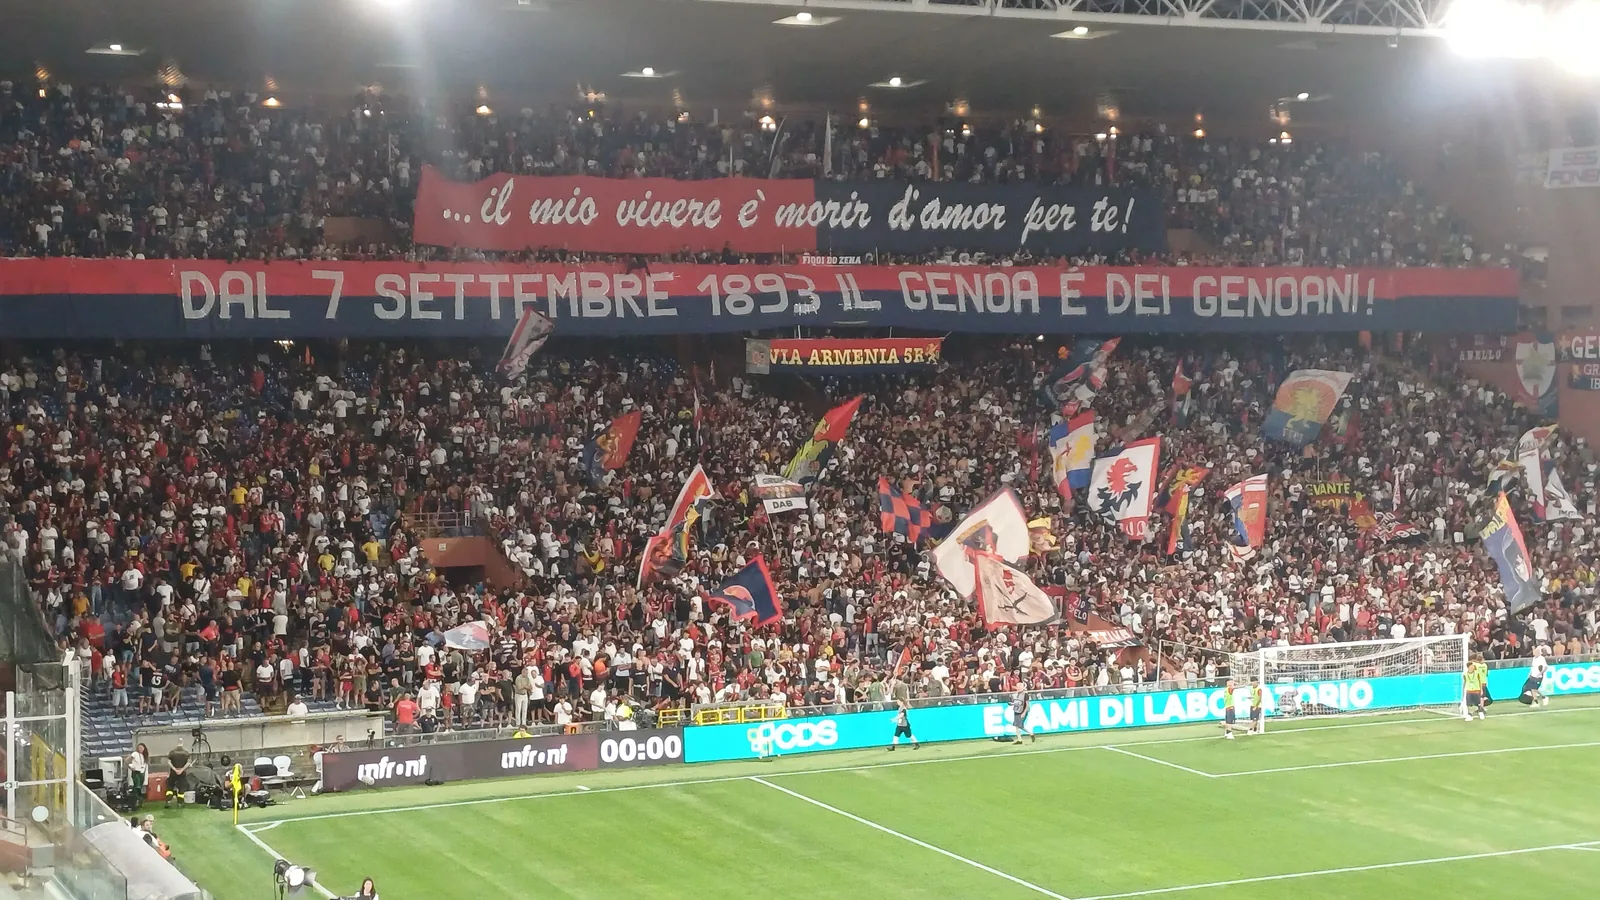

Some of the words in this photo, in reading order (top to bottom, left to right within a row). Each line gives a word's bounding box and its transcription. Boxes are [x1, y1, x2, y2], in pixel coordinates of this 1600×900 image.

[529, 187, 598, 225] mio
[616, 190, 722, 229] vivere
[774, 190, 872, 229] morir
[887, 184, 1007, 232] d'amor
[1020, 196, 1077, 246] per
[1089, 197, 1136, 234] te!
[180, 271, 291, 320] DAL
[311, 269, 344, 320] 7
[373, 271, 680, 321] SETTEMBRE
[697, 272, 822, 317] 1893
[898, 270, 1041, 315] GENOA
[1105, 272, 1172, 316] DEI
[769, 348, 803, 365] VIA
[807, 347, 900, 366] ARMENIA
[1571, 335, 1600, 359] GE
[772, 500, 794, 509] DAB
[1099, 696, 1134, 726] DI
[600, 734, 682, 763] 00:00
